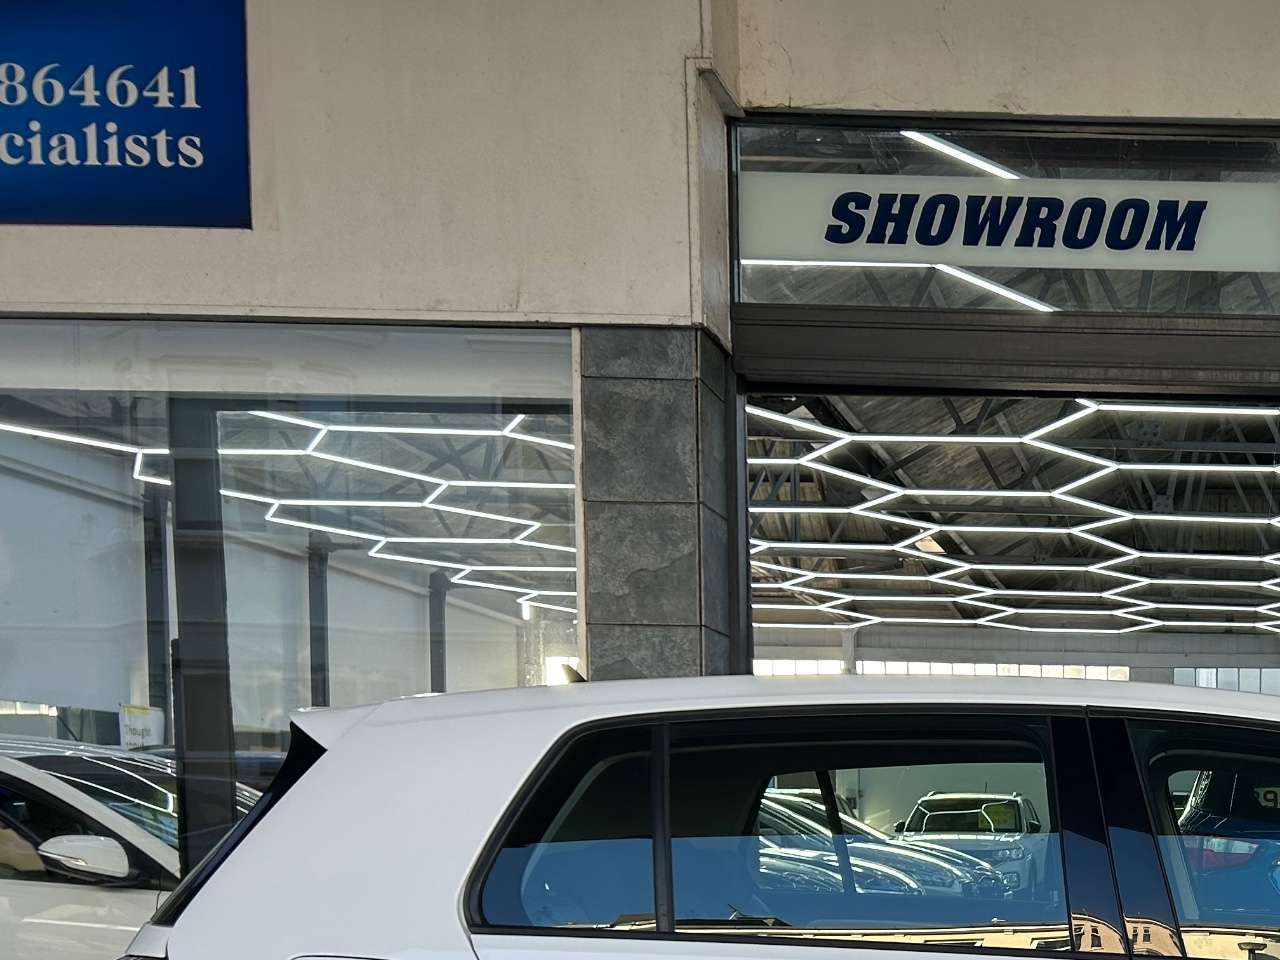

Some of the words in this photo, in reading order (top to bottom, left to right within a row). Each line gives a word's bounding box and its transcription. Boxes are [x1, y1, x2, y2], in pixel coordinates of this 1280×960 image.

[0, 62, 202, 109] 864641
[0, 119, 205, 168] cialists
[824, 191, 1208, 252] SHOWROOM
